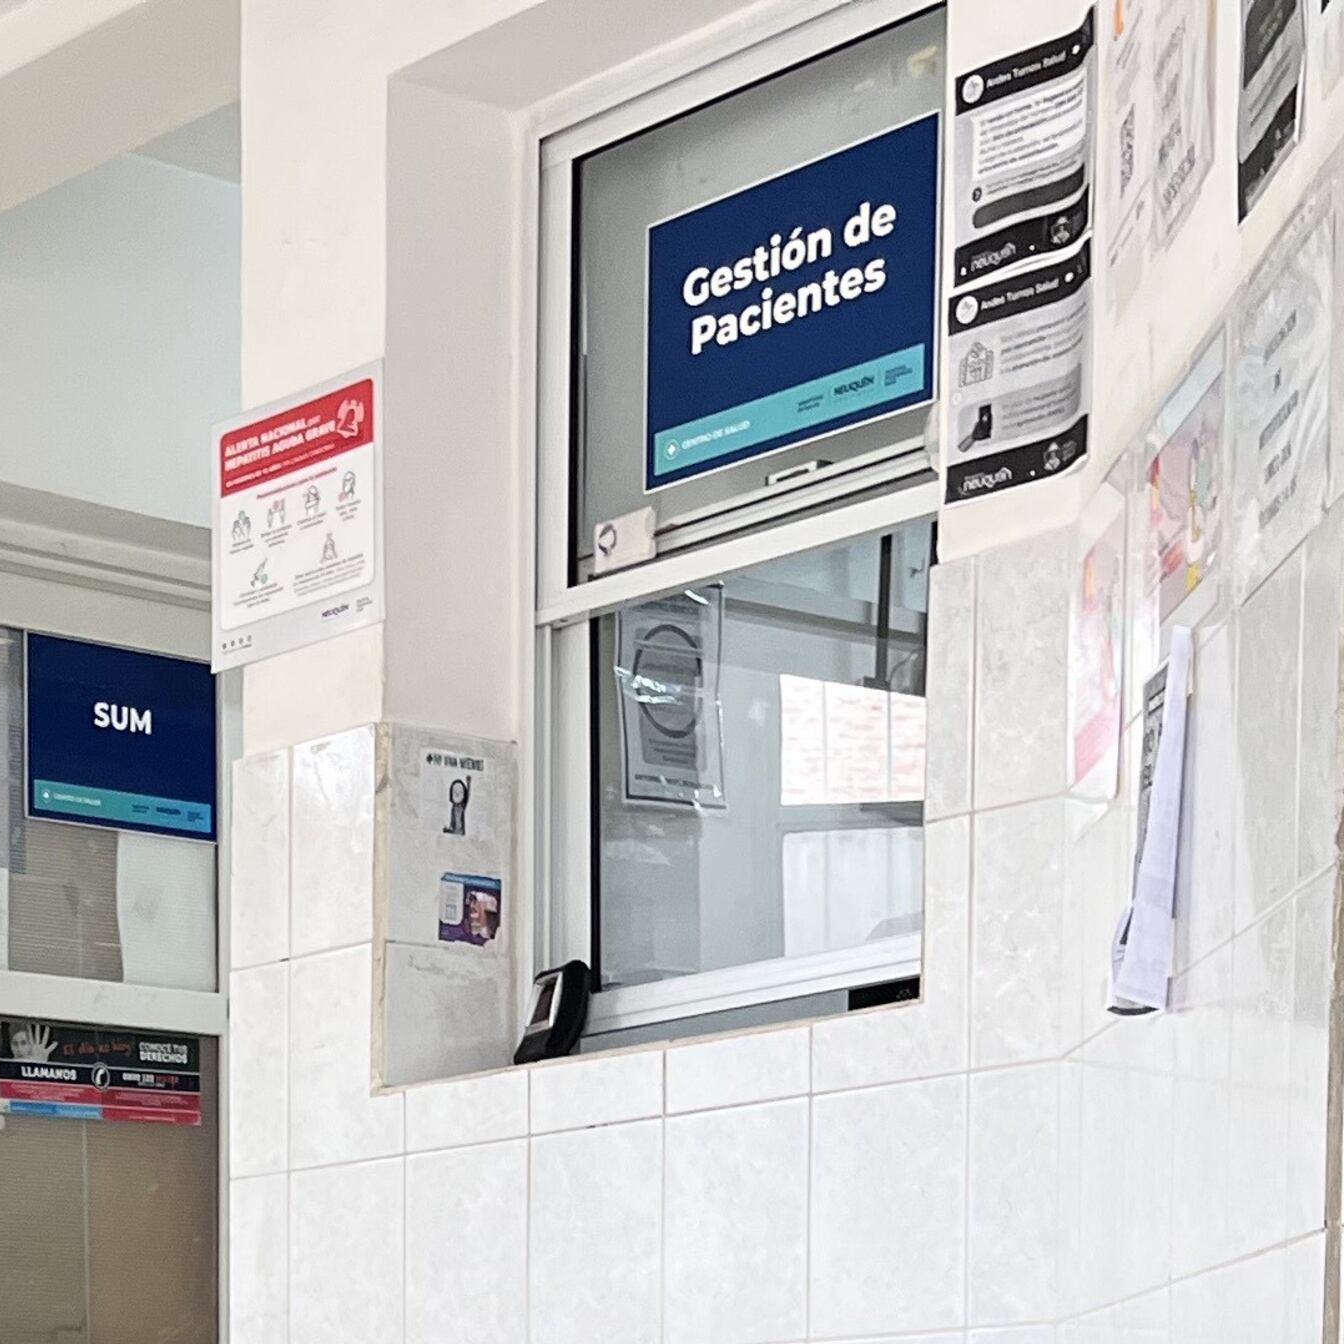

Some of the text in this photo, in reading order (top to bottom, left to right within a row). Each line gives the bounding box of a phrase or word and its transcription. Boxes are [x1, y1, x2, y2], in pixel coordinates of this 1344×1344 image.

[683, 201, 896, 306] Gestión de
[691, 258, 886, 355] Pacientes
[94, 702, 152, 735] SUM
[20, 1066, 77, 1080] LLAMANOS
